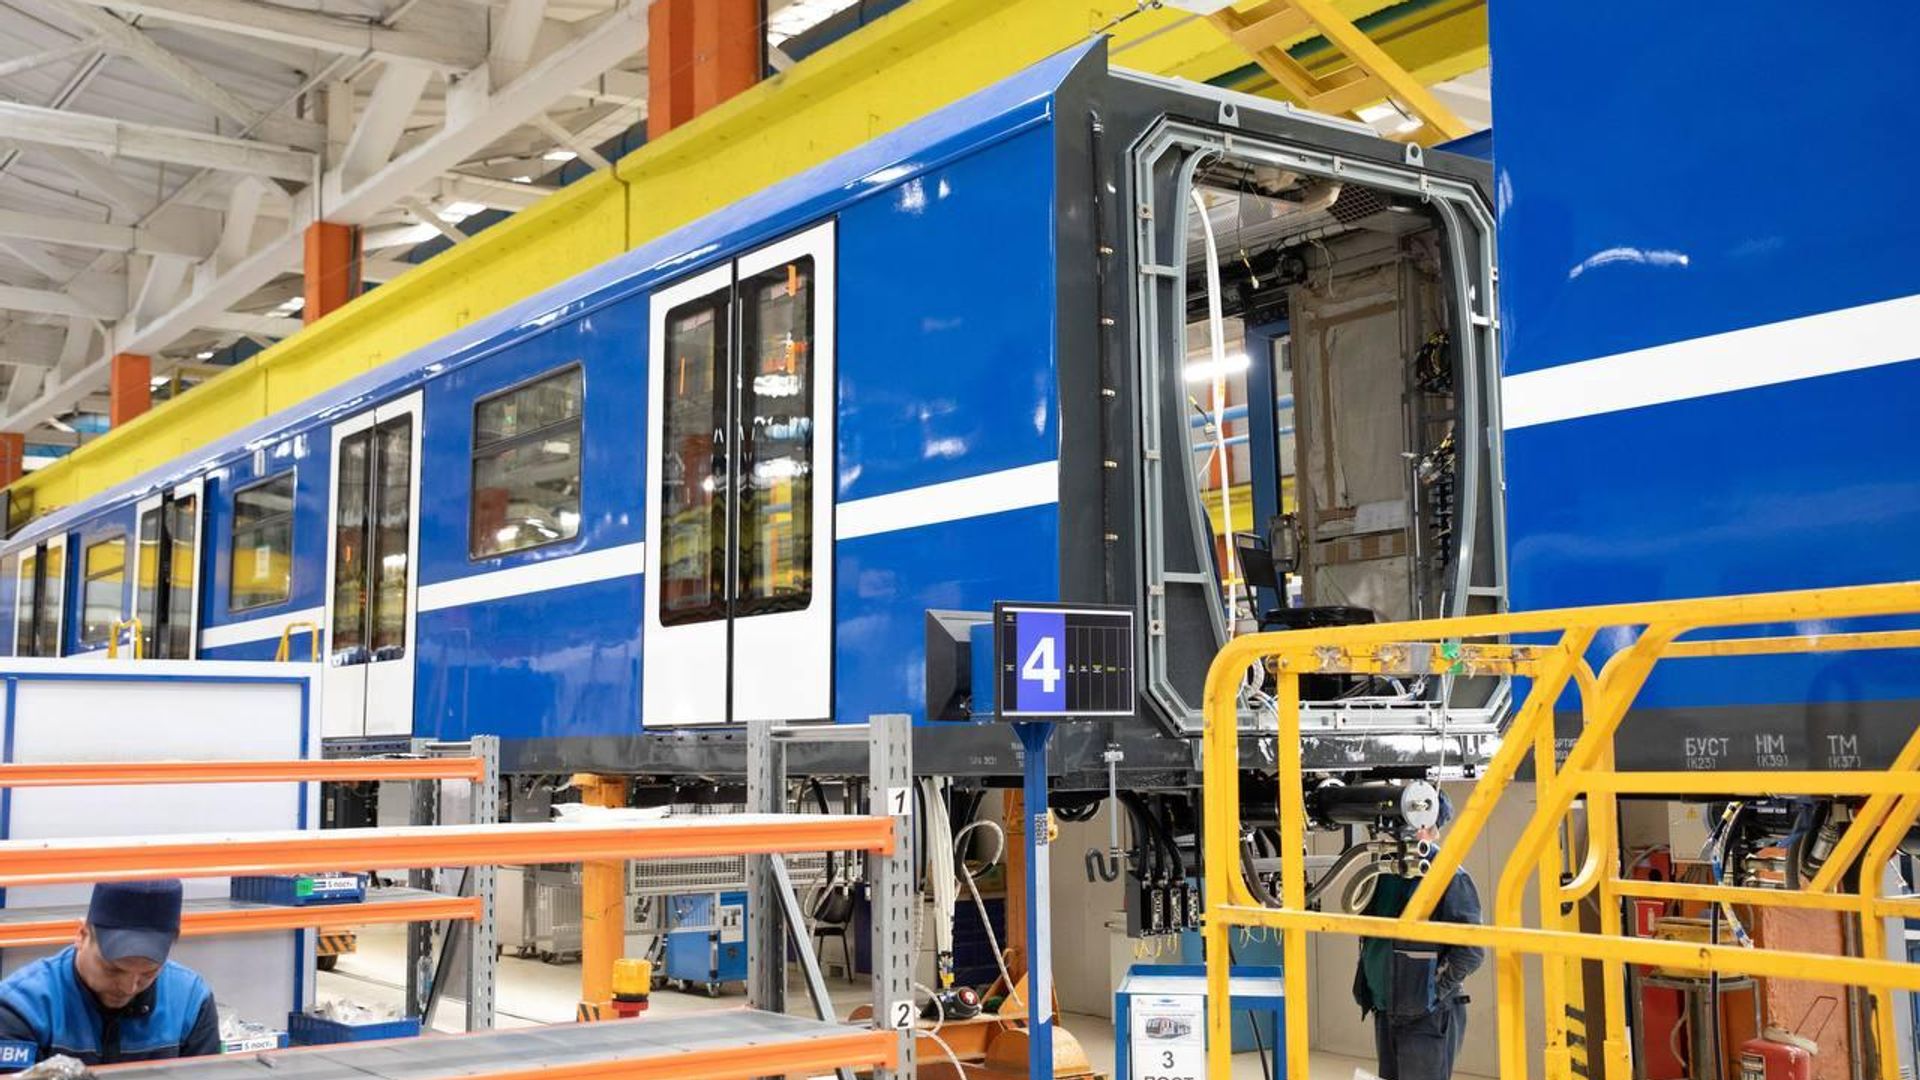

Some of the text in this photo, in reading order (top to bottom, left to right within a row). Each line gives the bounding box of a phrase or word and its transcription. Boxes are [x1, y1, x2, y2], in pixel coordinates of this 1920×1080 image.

[1022, 636, 1061, 693] 4
[1684, 737, 1729, 757] БУСТ
[1755, 734, 1785, 754] НМ
[1827, 734, 1858, 755] ТМ
[894, 790, 905, 814] 1
[897, 1003, 910, 1026] 2
[0, 1046, 29, 1062] ВМ
[1162, 1050, 1175, 1069] 3
